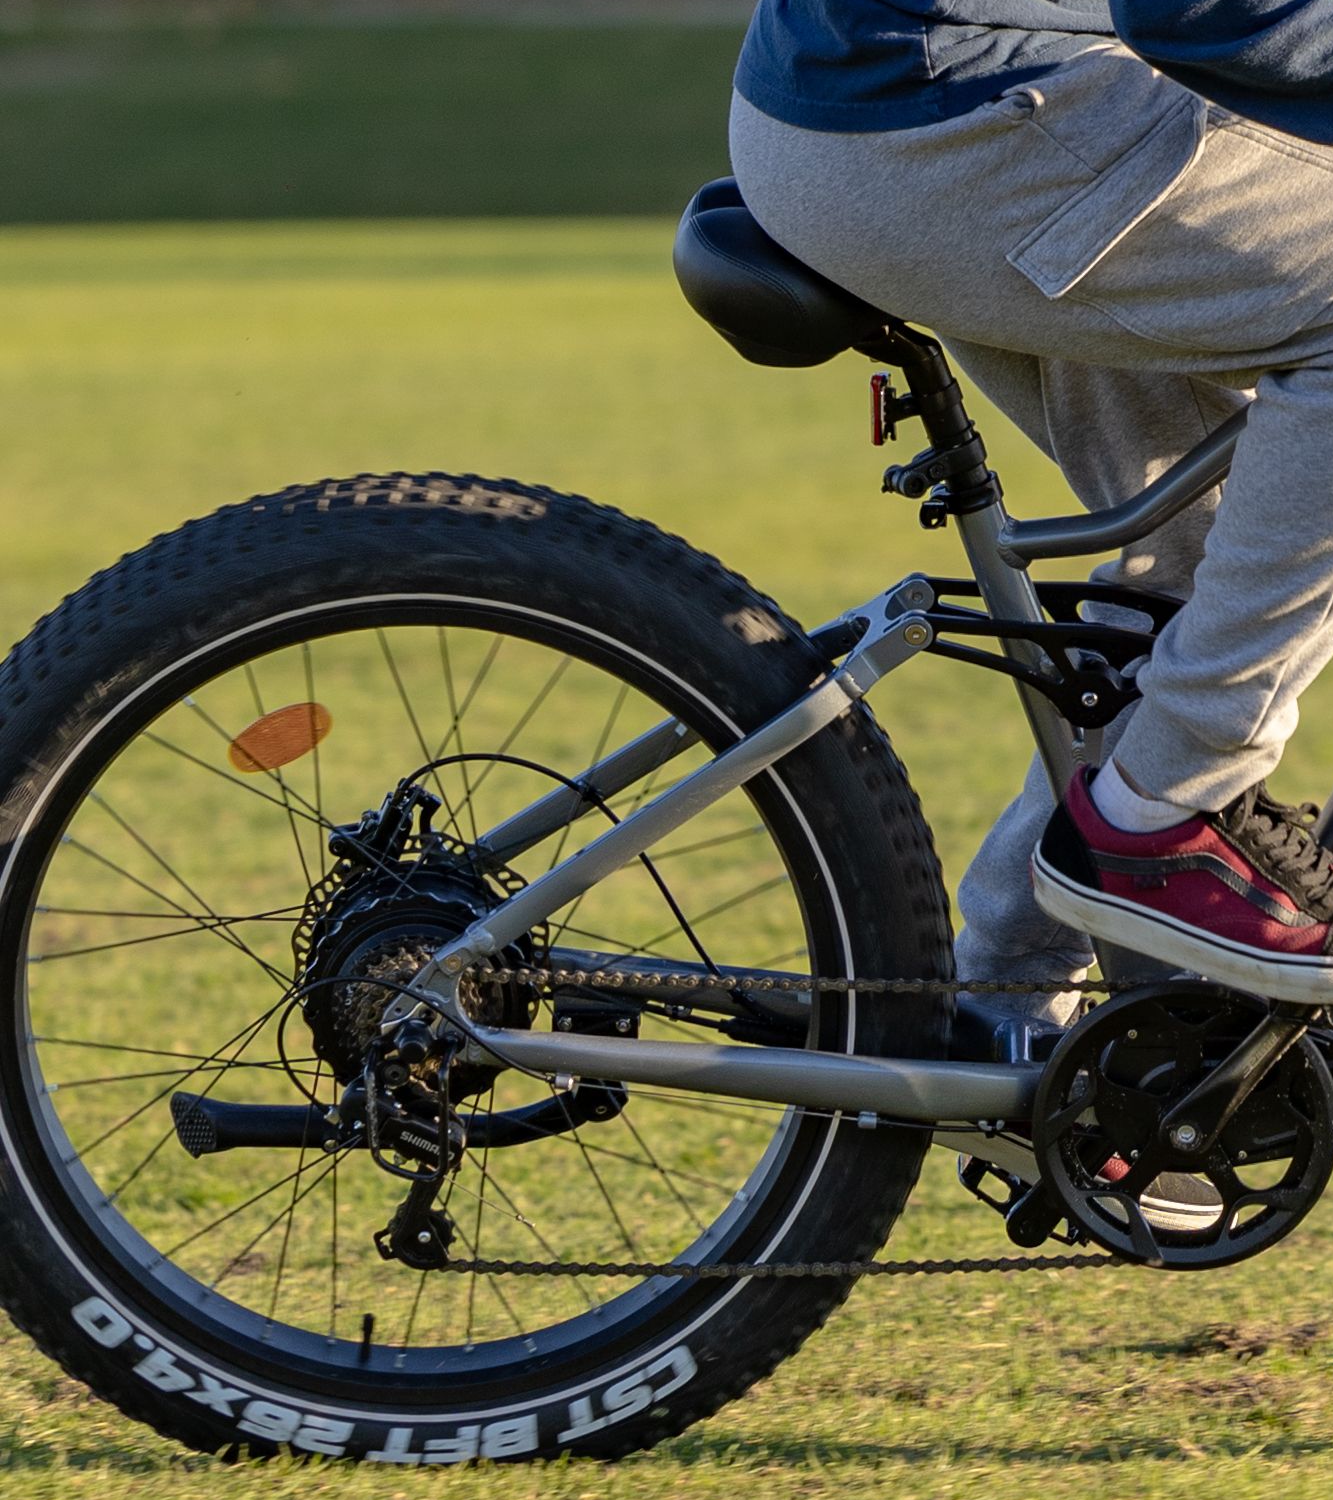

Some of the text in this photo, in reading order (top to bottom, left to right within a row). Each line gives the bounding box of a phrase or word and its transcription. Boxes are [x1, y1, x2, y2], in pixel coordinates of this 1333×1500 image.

[401, 1131, 454, 1161] SHIMAO
[71, 1296, 698, 1463] CST BFT 26x4.0
